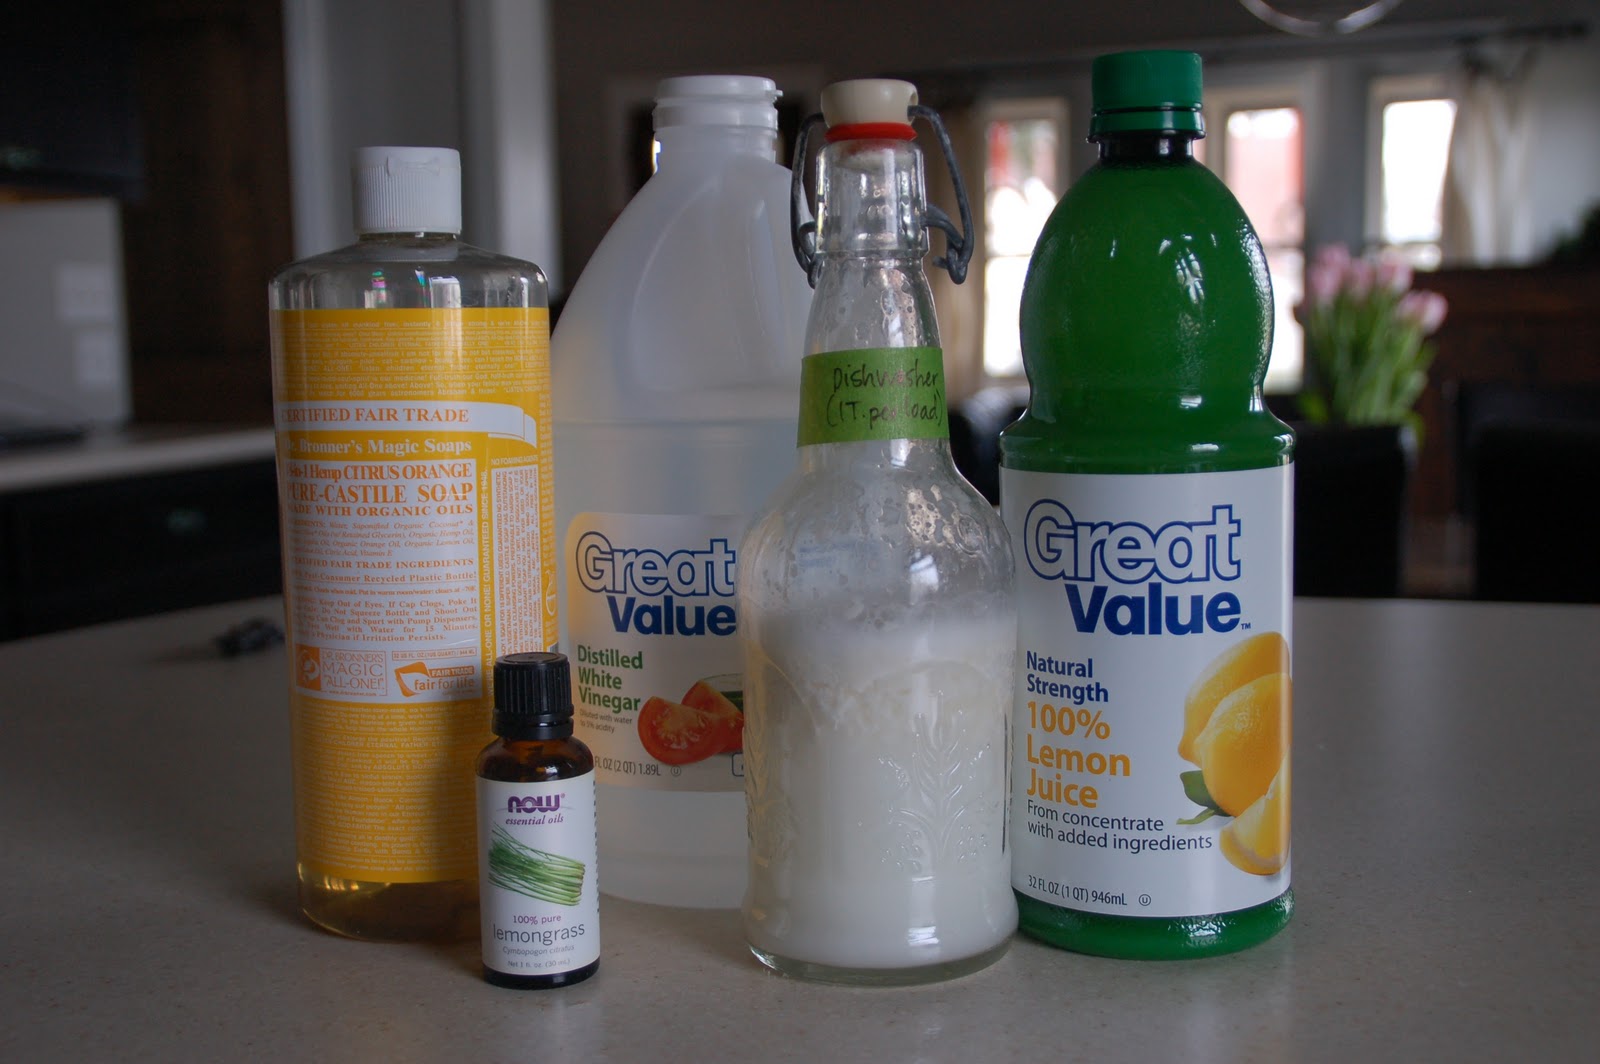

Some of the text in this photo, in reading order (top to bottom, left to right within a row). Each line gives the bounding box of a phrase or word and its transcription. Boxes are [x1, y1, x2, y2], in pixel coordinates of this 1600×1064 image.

[354, 408, 400, 422] FAIR
[403, 408, 470, 423] TRADE
[367, 439, 419, 457] Magic
[423, 438, 472, 455] Soaps
[310, 463, 342, 482] Hemp
[343, 465, 400, 481] CITRUS
[401, 463, 472, 480] ORANGE
[287, 482, 474, 504] PURE-CASTILE SOAP
[315, 505, 352, 517] WITH
[355, 506, 432, 518] ORGANIC
[436, 504, 474, 515] OILS
[480, 493, 489, 520] SINCE
[393, 521, 424, 531] Organic
[1024, 498, 1241, 585] Great
[481, 521, 490, 582] GUARANTEED
[330, 558, 475, 570] FAIR TRADE INGREDIENTS
[575, 530, 736, 598] Great
[363, 574, 406, 585] Recycled
[409, 574, 442, 583] Plastic
[445, 571, 477, 581] Bottle!
[338, 600, 351, 608] Out
[354, 600, 362, 608] of
[399, 601, 416, 610] Cap
[447, 598, 467, 607] Poke
[482, 584, 491, 612] NONE!
[350, 609, 381, 618] Squeeze
[385, 609, 410, 617] Bottle
[414, 609, 430, 617] and
[434, 607, 458, 616] Shoot
[606, 595, 737, 636] Value
[1064, 582, 1241, 635] Value
[346, 624, 363, 633] with
[370, 625, 395, 634] Water
[403, 625, 416, 633] for
[425, 625, 435, 633] 15
[363, 617, 385, 627] Spurt
[407, 617, 432, 626] Pump
[483, 613, 492, 628] OR
[363, 634, 405, 642] Irritation
[483, 629, 493, 668] ALL-ONE
[577, 644, 643, 670] Distilled
[322, 661, 383, 677] MAGIC
[431, 667, 474, 677] FAIR TRADE
[1027, 650, 1093, 679] Natural
[414, 676, 475, 691] fair for life
[578, 666, 622, 690] White
[1027, 673, 1109, 705] Strength
[578, 686, 641, 714] Vinegar
[599, 713, 613, 722] with
[613, 717, 633, 725] water
[1027, 701, 1110, 740] 100%
[595, 724, 616, 735] acidity
[1027, 733, 1131, 777] Lemon
[603, 757, 613, 771] OZ
[613, 759, 621, 774] (2
[622, 761, 636, 776] QT)
[637, 763, 661, 776] 1.89L
[1027, 768, 1098, 808] Juice
[505, 813, 565, 826] essential oils
[1027, 799, 1164, 832] From concentrate
[1027, 821, 1213, 855] with added ingredients
[1028, 874, 1037, 890] 32
[1038, 878, 1047, 893] FL
[1048, 881, 1060, 897] OZ
[1061, 884, 1070, 900] (1
[1072, 886, 1090, 904] QT)
[1091, 890, 1128, 907] 946mL
[512, 914, 562, 925] 100% pure
[493, 923, 586, 946] lemongrass
[502, 944, 575, 957] Cymbopogon citratus
[507, 960, 519, 968] Net
[545, 959, 557, 968] (30
